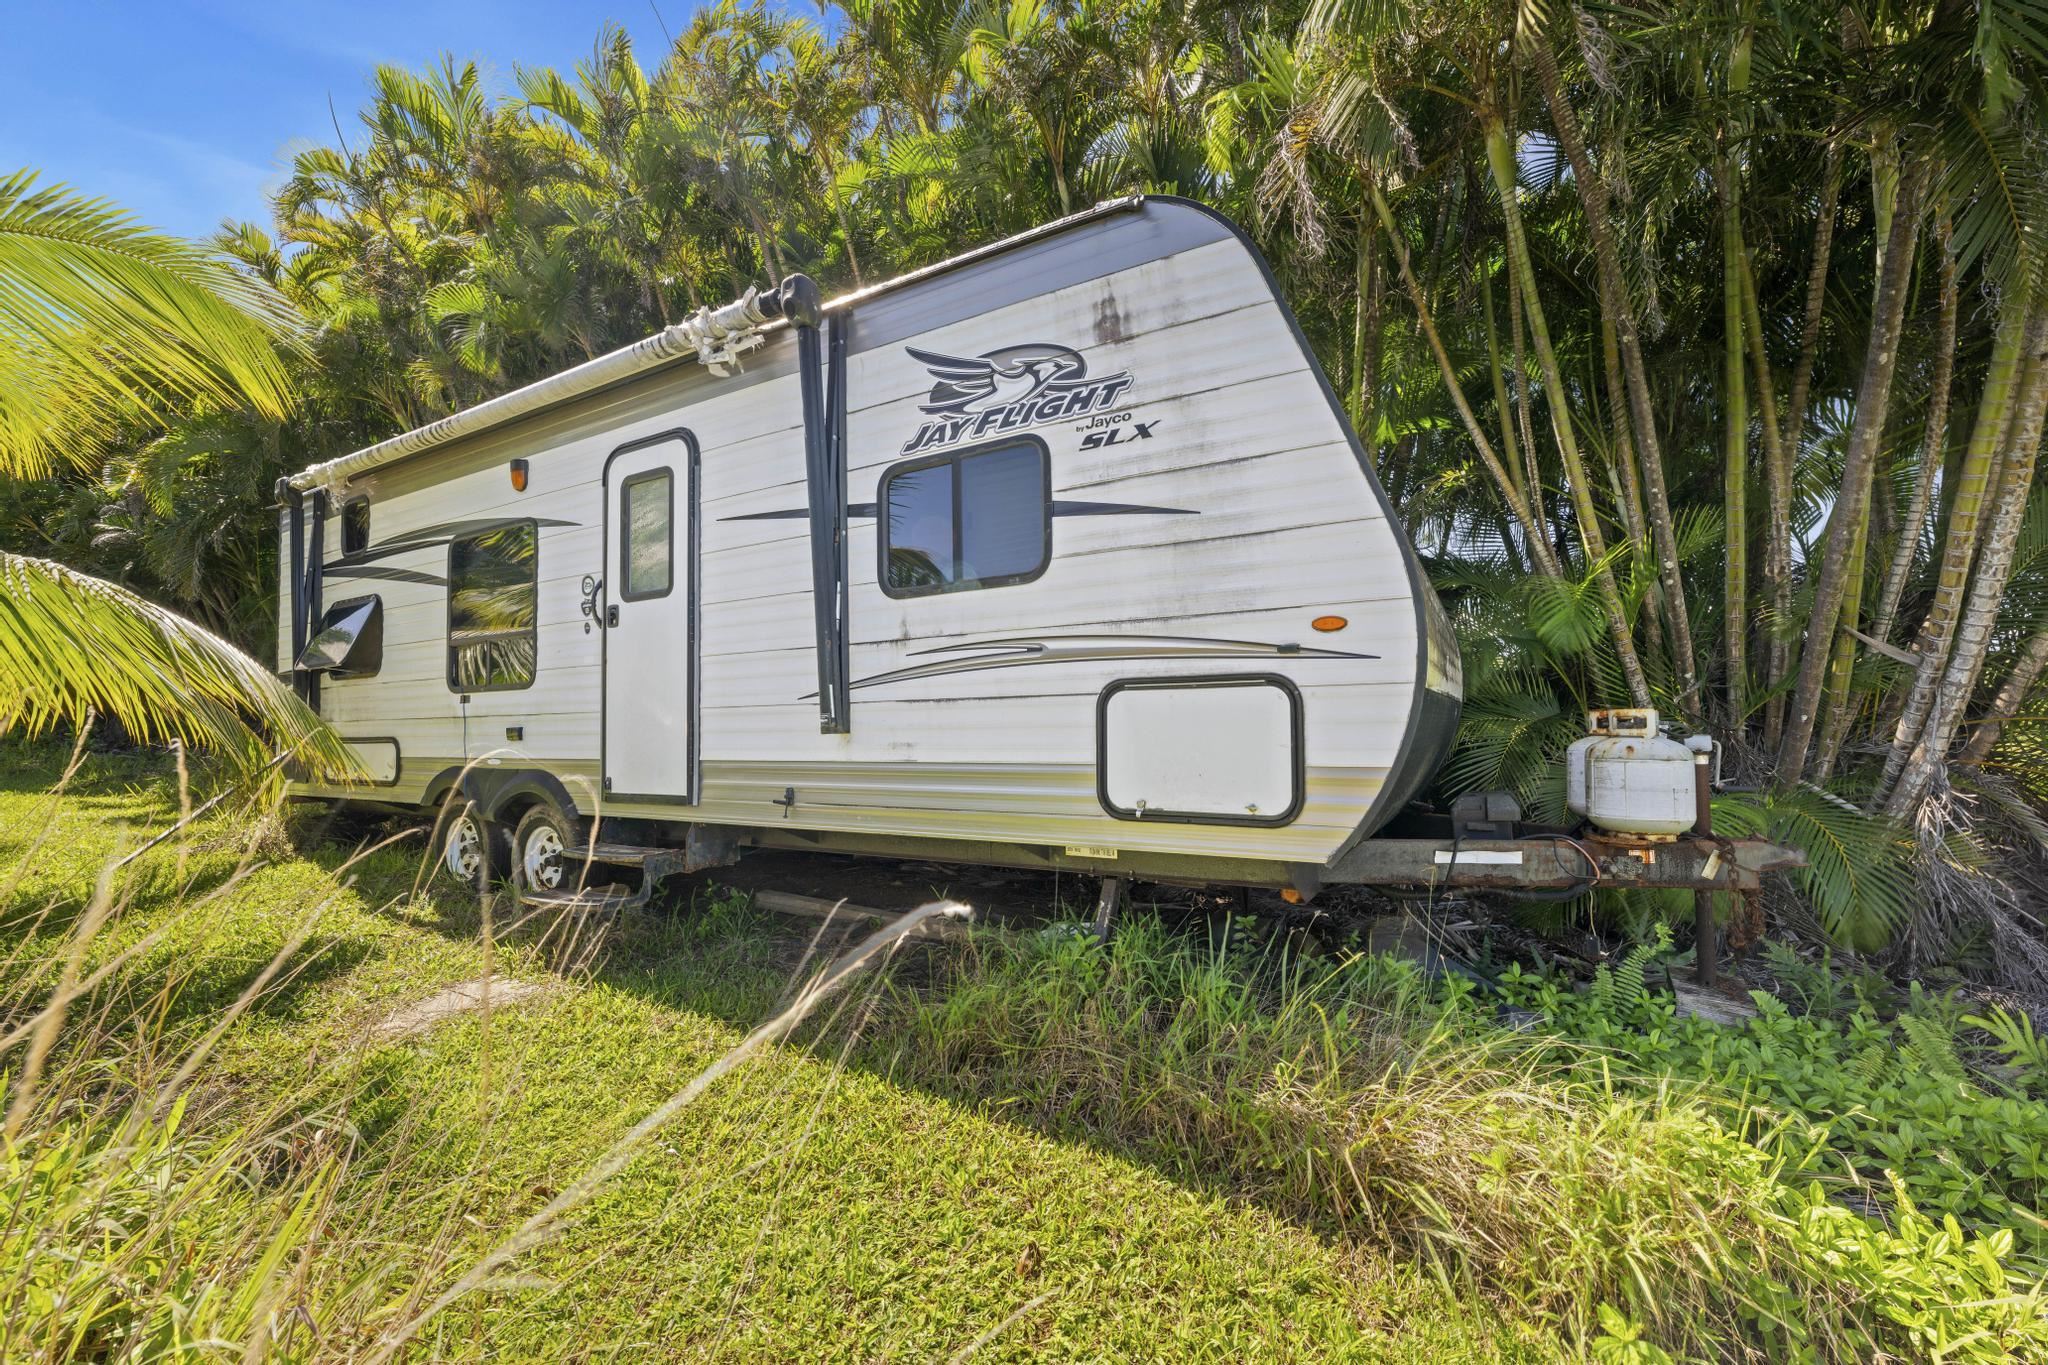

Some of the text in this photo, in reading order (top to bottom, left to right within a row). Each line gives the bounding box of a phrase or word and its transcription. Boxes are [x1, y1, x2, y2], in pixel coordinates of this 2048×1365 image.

[901, 376, 1133, 455] JAY FLIGHT
[1085, 412, 1132, 430] Jayco
[1079, 420, 1162, 452] SLX
